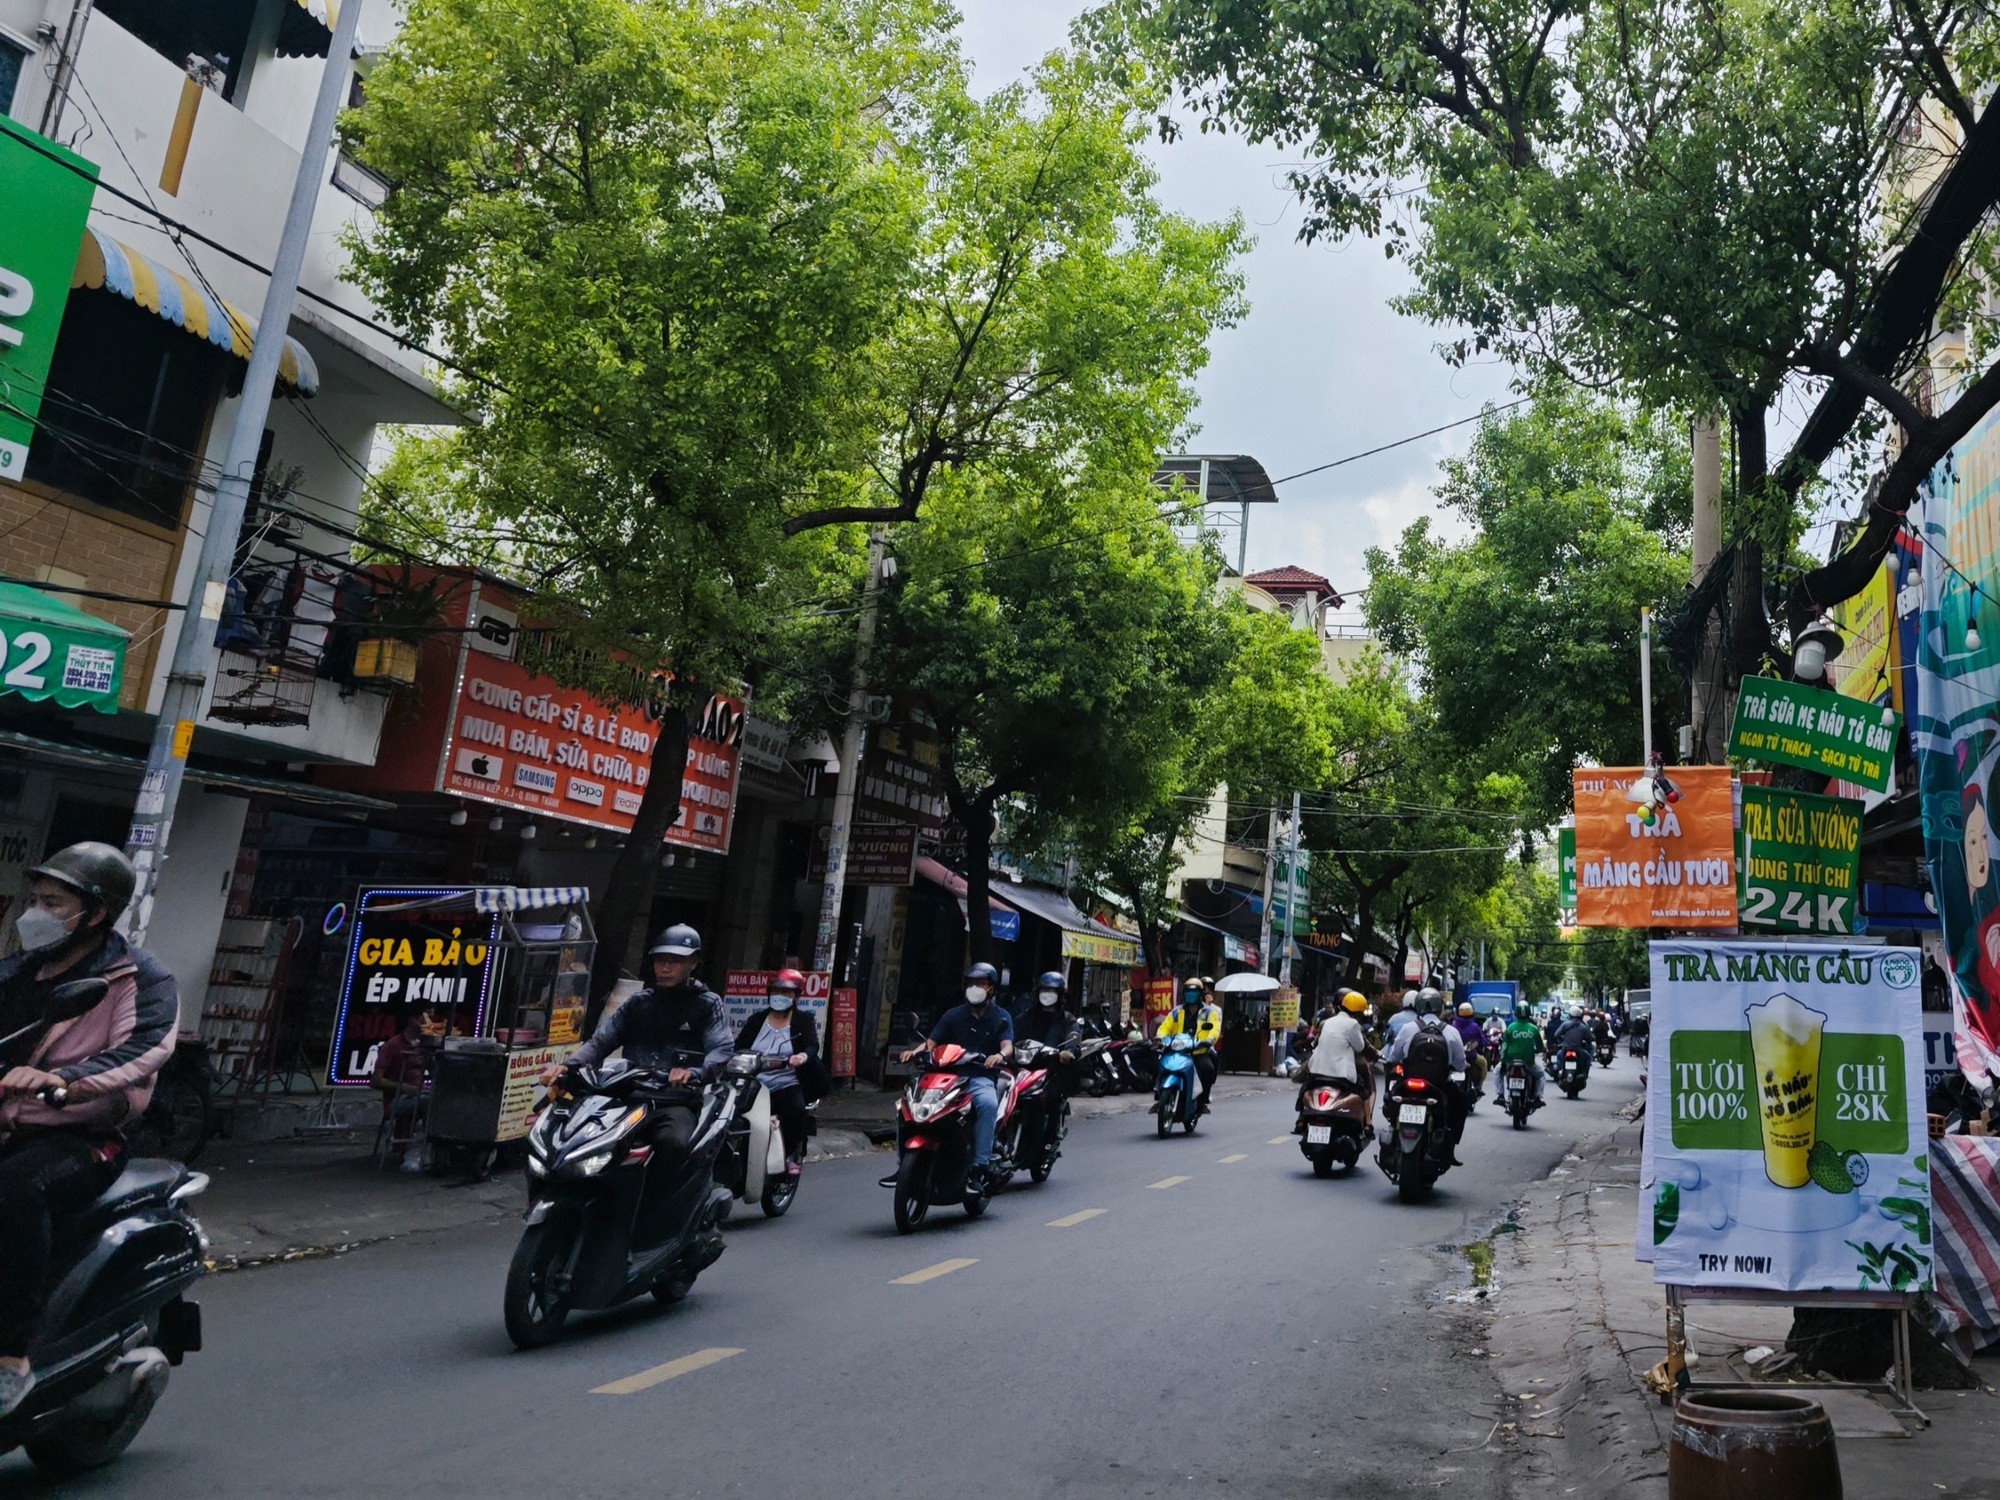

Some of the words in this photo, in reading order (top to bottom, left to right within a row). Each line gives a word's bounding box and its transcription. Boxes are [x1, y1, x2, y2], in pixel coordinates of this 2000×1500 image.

[467, 677, 522, 714] CUNG
[522, 693, 560, 725] CẤP
[561, 702, 582, 732] SỈ
[581, 713, 595, 737] &
[594, 712, 618, 744] LẺ
[618, 726, 651, 754] BAO
[1743, 692, 1768, 720] TRÀ
[1768, 695, 1795, 726] SỮA
[1797, 704, 1817, 735] MẸ
[1817, 702, 1845, 738] NẤU
[1847, 715, 1866, 744] TỚ
[1865, 721, 1893, 753] BÁN
[460, 714, 506, 749] MUA
[508, 728, 553, 764] BÁN,
[554, 737, 589, 771] SỬA
[591, 753, 633, 784] CHỮA
[1739, 731, 1764, 748] NGON
[1766, 732, 1781, 751] TỪ
[1781, 738, 1811, 758] THẠCH
[1821, 747, 1846, 768] SẠCH
[1848, 754, 1862, 772] TỪ
[1863, 760, 1881, 779] TRÀ
[518, 766, 555, 790] SAMSUNG
[570, 781, 603, 799] oppo
[1626, 804, 1682, 838] TRÀ
[1744, 796, 1773, 842] TRÀ
[1775, 797, 1806, 844] SỮA
[1808, 803, 1858, 852] NƯỚNG
[1583, 855, 1642, 888] MĂNG
[1644, 847, 1682, 886] CẦU
[1684, 857, 1729, 886] TƯƠI
[1793, 855, 1822, 885] THỬ
[1824, 862, 1852, 889] CHỈ
[1651, 908, 1665, 917] TRÀ
[1741, 887, 1849, 935] 24K
[358, 937, 416, 967] GIA
[421, 926, 488, 967] BẢO
[1309, 932, 1340, 948] TRANG
[728, 975, 748, 986] MUA
[749, 972, 768, 986] BÁN
[1664, 950, 1720, 983] TRÀ
[1725, 950, 1810, 985] MĂNG
[1816, 948, 1875, 986] CẦU
[365, 971, 401, 1003] ÉP
[725, 997, 742, 1005] MUA
[744, 997, 760, 1005] BÁN
[1145, 992, 1172, 1012] 35K
[812, 999, 825, 1007] GỌI
[1512, 1029, 1533, 1039] Grab
[1676, 1060, 1745, 1092] TƯƠI
[1836, 1054, 1888, 1093] CHỈ
[1676, 1091, 1748, 1121] 100%
[1764, 1084, 1781, 1103] MẸ
[1787, 1092, 1812, 1115] BÁN
[1835, 1092, 1891, 1123] 28K
[1699, 1253, 1728, 1273] TRY
[1734, 1254, 1772, 1275] NOW!
